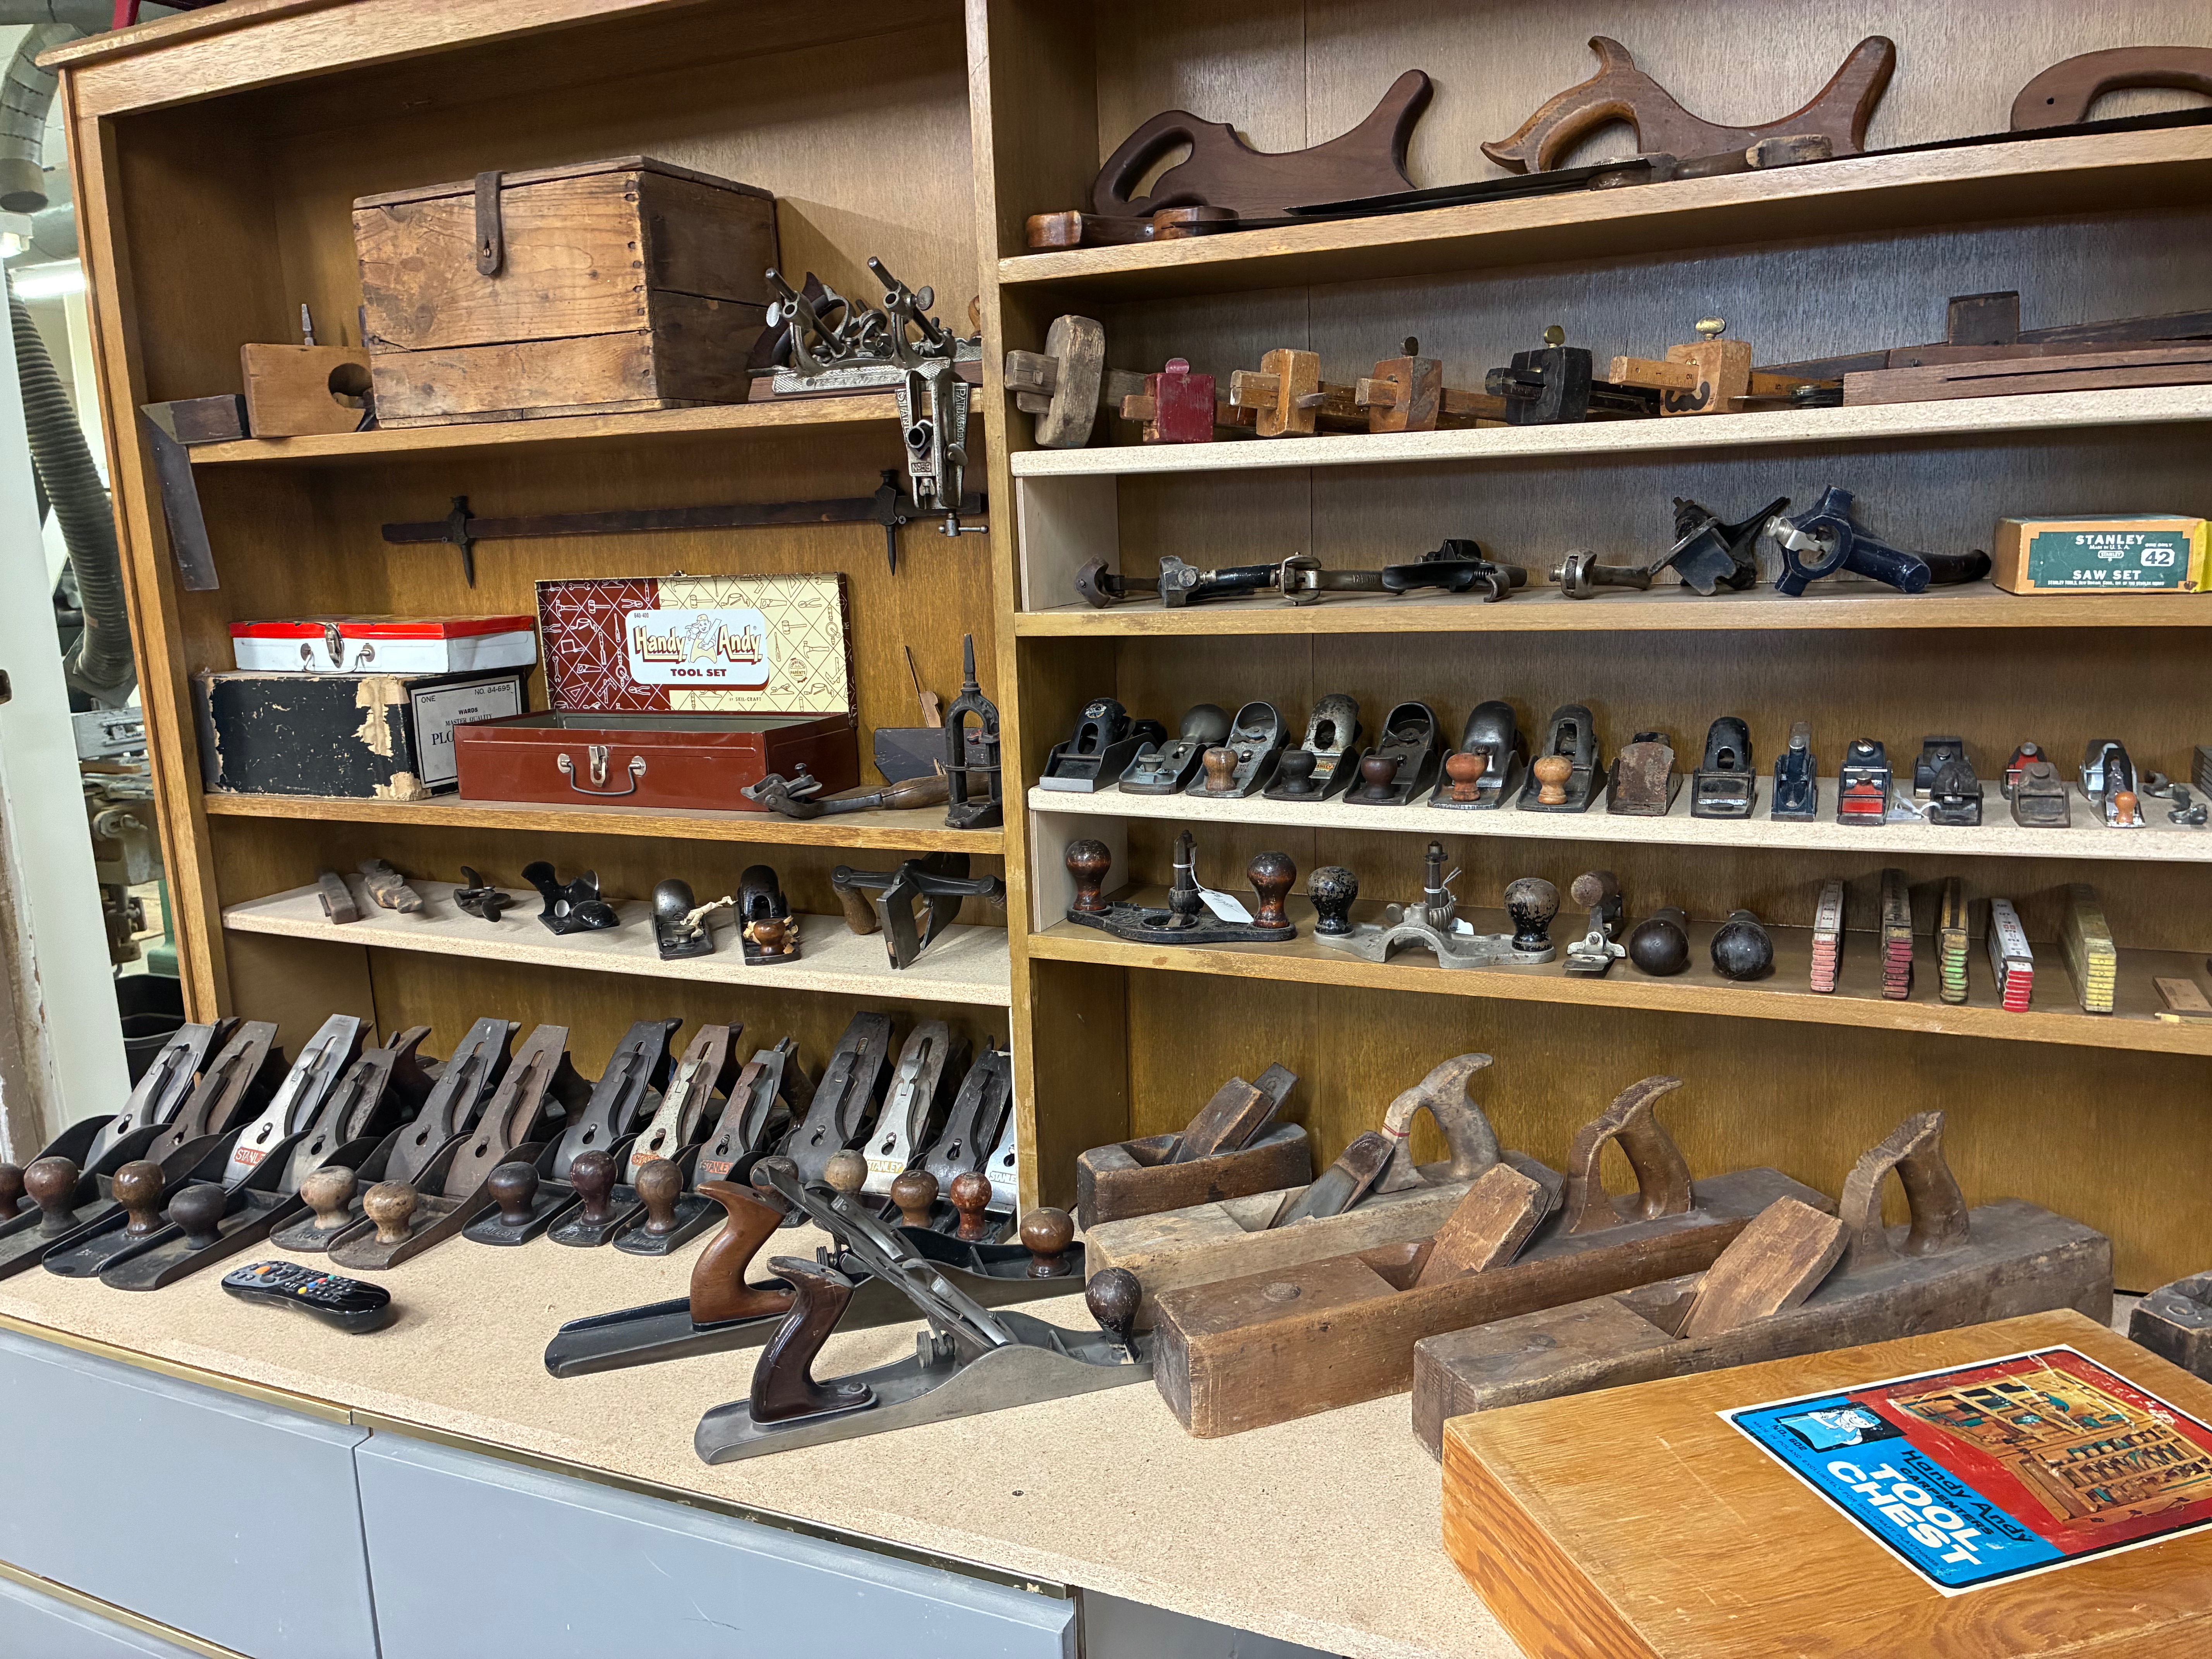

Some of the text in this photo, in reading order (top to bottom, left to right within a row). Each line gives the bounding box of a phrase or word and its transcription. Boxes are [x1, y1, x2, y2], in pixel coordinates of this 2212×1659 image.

[897, 392, 910, 434] STANL
[2075, 534, 2145, 544] STANLEY
[2145, 551, 2170, 565] 42
[2073, 570, 2142, 580] SAW SET
[633, 624, 763, 665] Handy Andy
[421, 695, 436, 703] ONE
[487, 684, 511, 694] 84-695
[445, 713, 493, 726] MASTER QUALITY
[235, 1149, 266, 1164] STANL
[989, 1171, 1016, 1183] STANLE
[1771, 1424, 1786, 1437] NO.
[1788, 1438, 1808, 1451] 602
[1780, 1440, 1802, 1459] POLAND
[1802, 1459, 1843, 1491] EXCLUSIVELY
[1843, 1491, 1857, 1503] FOR
[1899, 1467, 1994, 1535] CARPENTERS
[1901, 1450, 2035, 1542] Handy Andy
[1827, 1461, 1983, 1565] CHEST
[1869, 1463, 1982, 1551] TOOL
